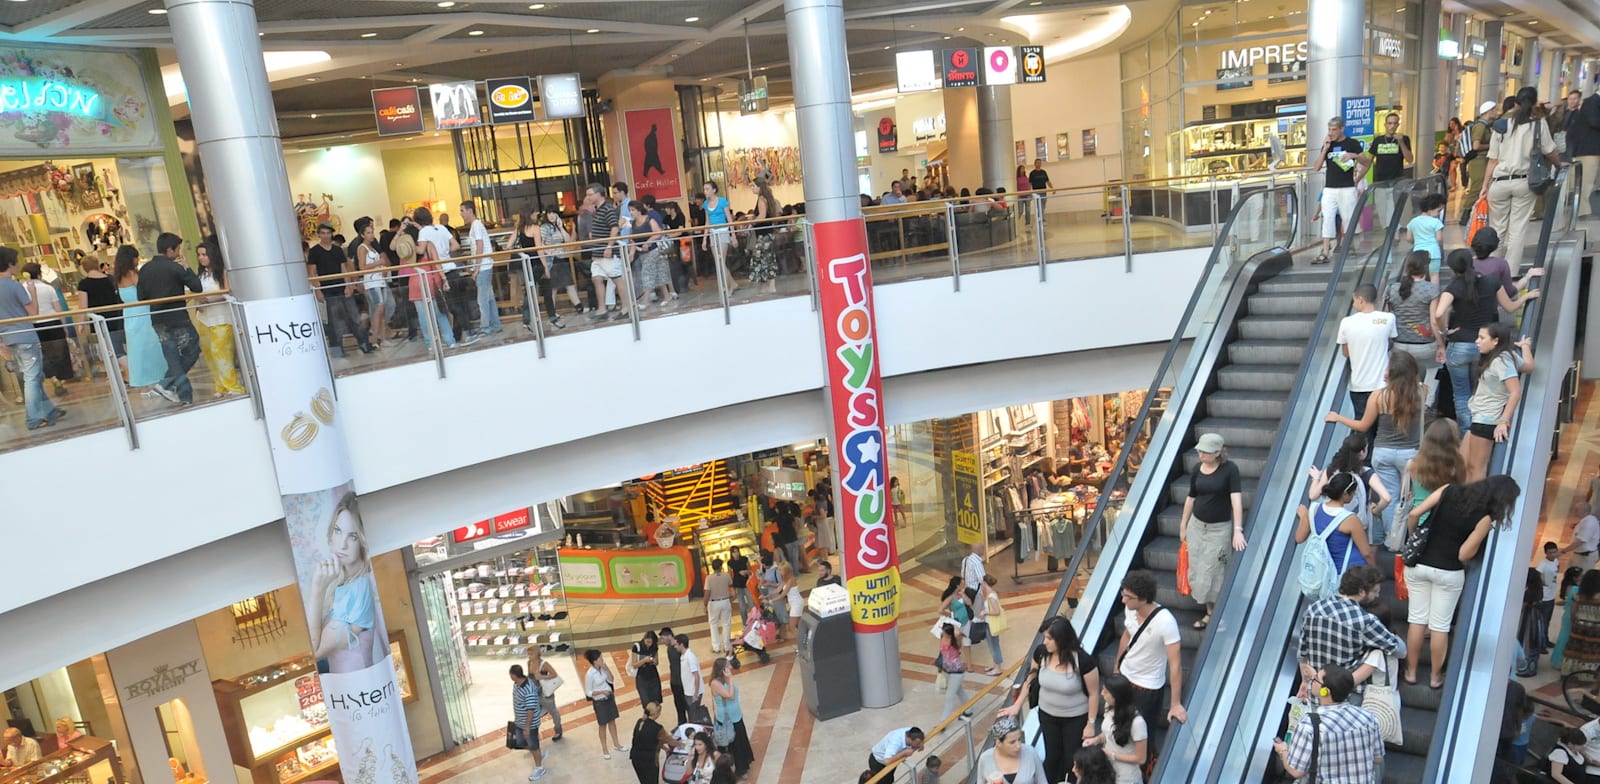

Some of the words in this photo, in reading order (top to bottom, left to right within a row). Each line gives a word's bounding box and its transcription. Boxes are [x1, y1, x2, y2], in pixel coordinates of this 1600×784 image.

[1346, 98, 1371, 110] מבצעים
[1346, 108, 1371, 119] מיוחדים
[656, 178, 678, 187] Hillel
[963, 492, 973, 508] 4
[958, 508, 979, 530] 100
[866, 575, 890, 590] חדש
[861, 608, 869, 620] 2
[871, 602, 896, 619] קומה
[125, 659, 201, 698] ROYALTY
